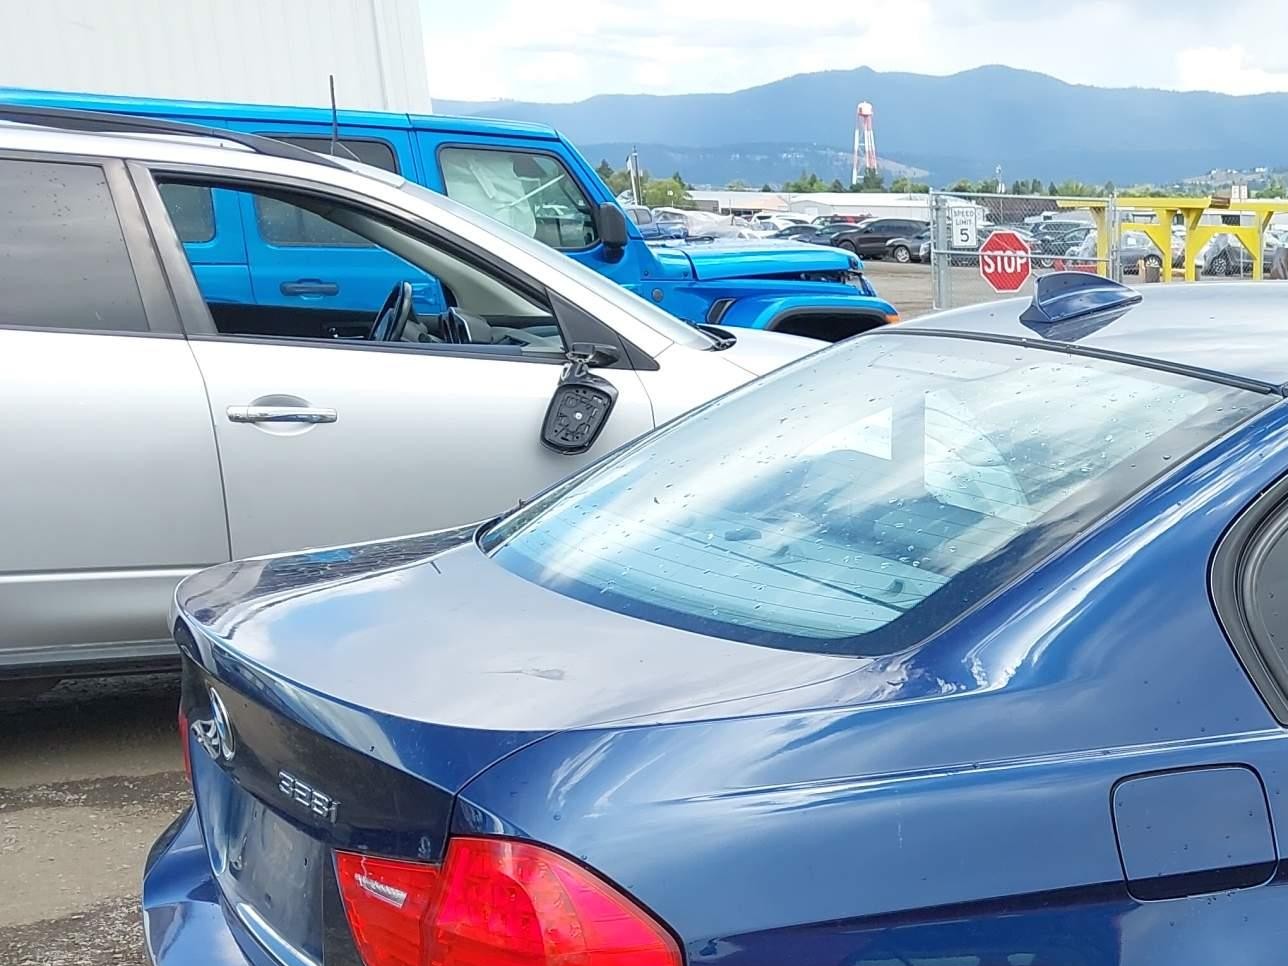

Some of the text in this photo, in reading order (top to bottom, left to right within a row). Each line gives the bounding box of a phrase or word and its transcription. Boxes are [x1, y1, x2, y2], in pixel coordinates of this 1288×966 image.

[953, 209, 975, 217] SPEED
[960, 228, 970, 243] 5
[983, 250, 1027, 274] STOP
